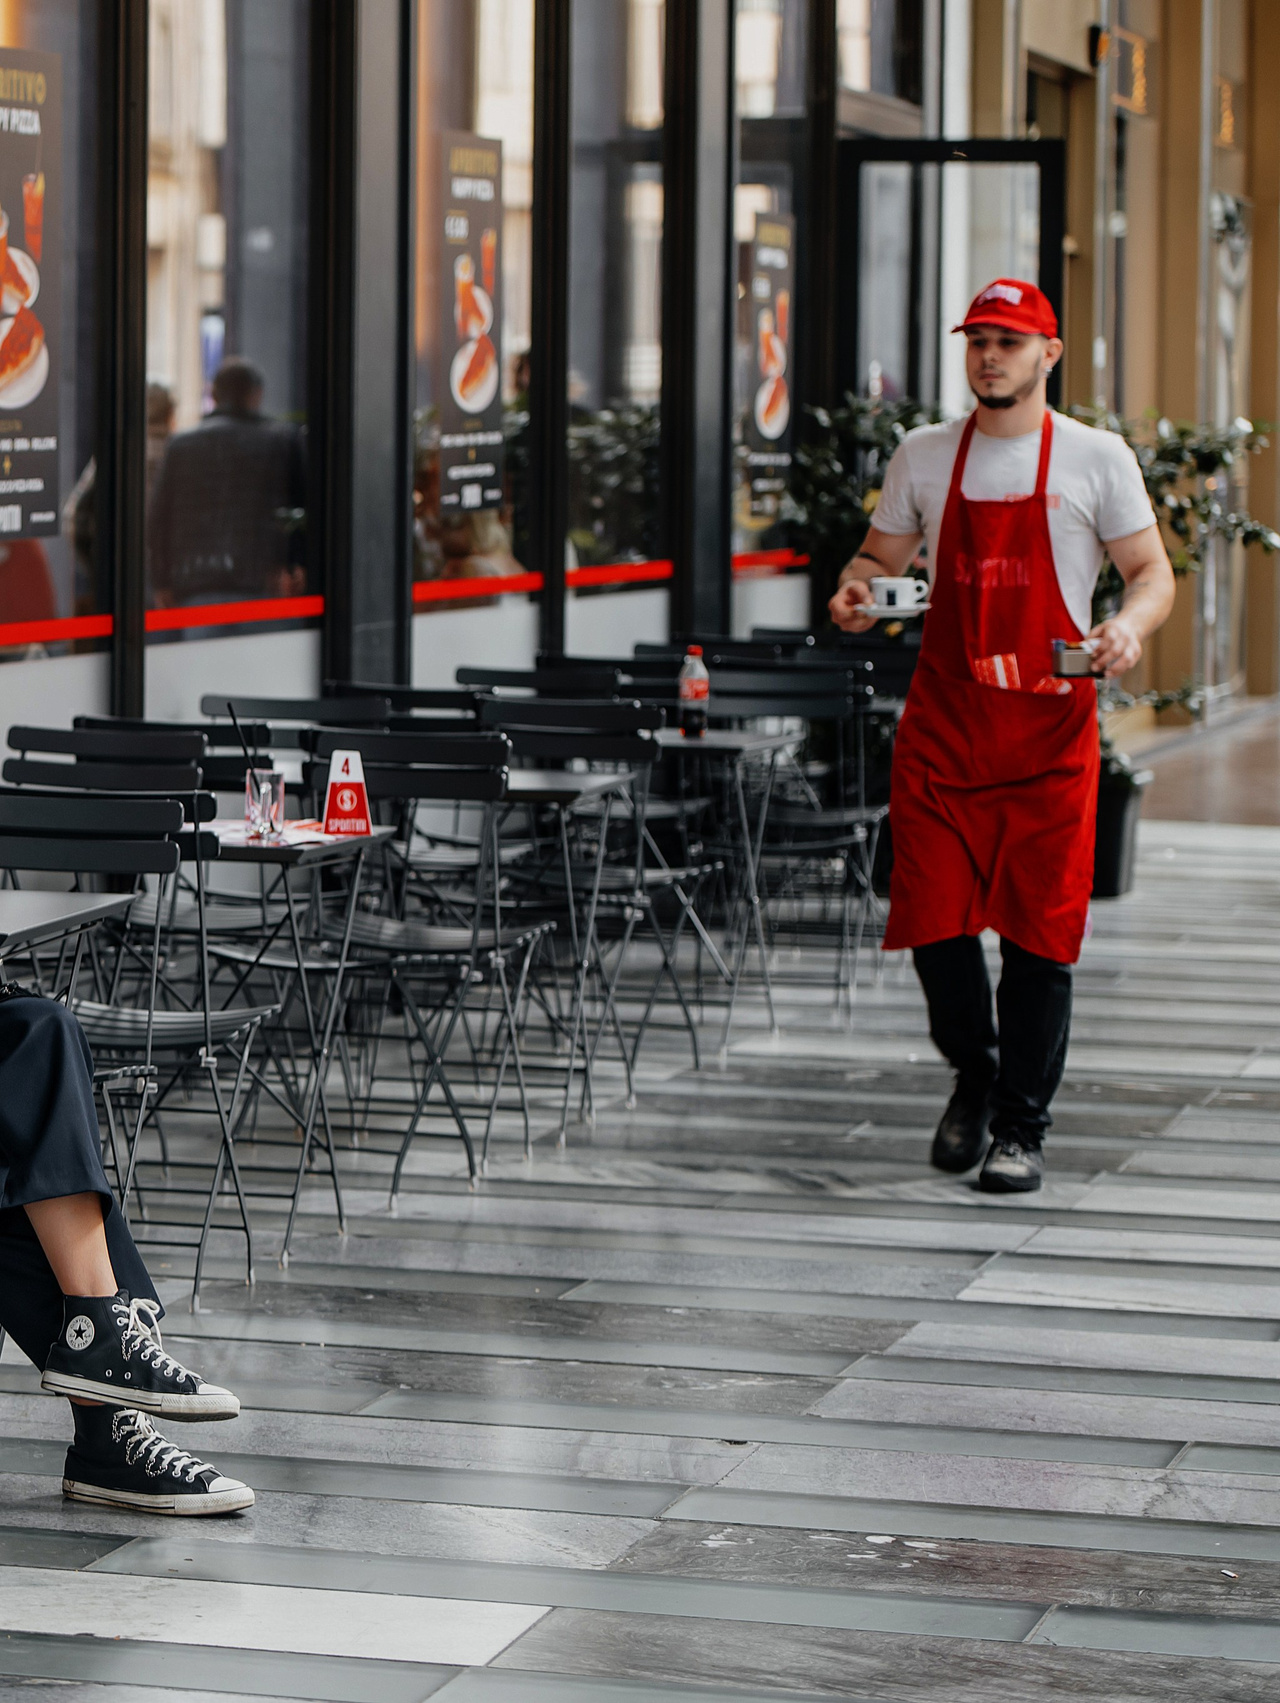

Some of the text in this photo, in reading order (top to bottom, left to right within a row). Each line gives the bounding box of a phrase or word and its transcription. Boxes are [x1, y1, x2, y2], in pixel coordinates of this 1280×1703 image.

[9, 107, 41, 135] PIZZA
[341, 757, 350, 775] 4
[328, 818, 367, 833] SPONTINI
